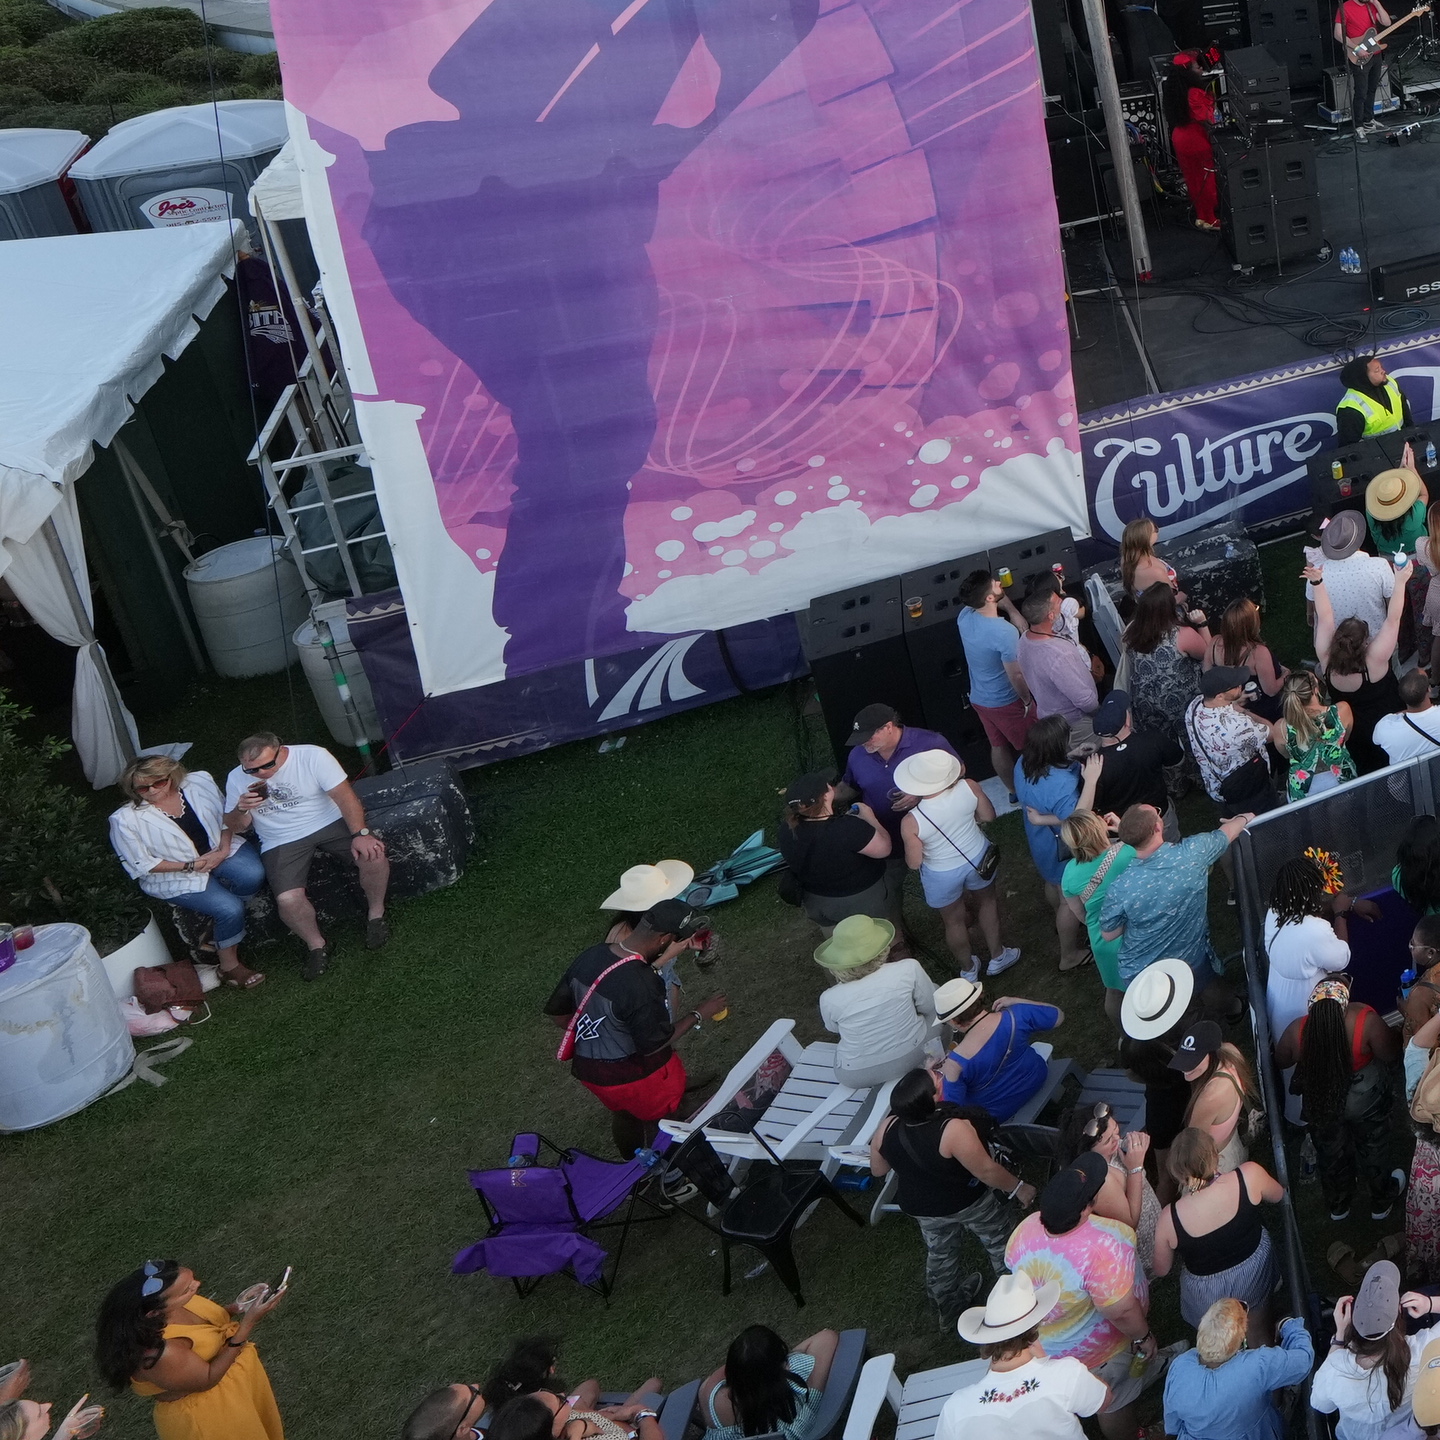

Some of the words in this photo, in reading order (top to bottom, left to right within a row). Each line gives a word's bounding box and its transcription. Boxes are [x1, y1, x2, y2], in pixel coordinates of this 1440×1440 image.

[158, 200, 196, 216] Joe's
[248, 310, 289, 328] ITA
[1094, 411, 1340, 546] Culture
[258, 804, 280, 815] DEVIL
[282, 800, 300, 810] DOG
